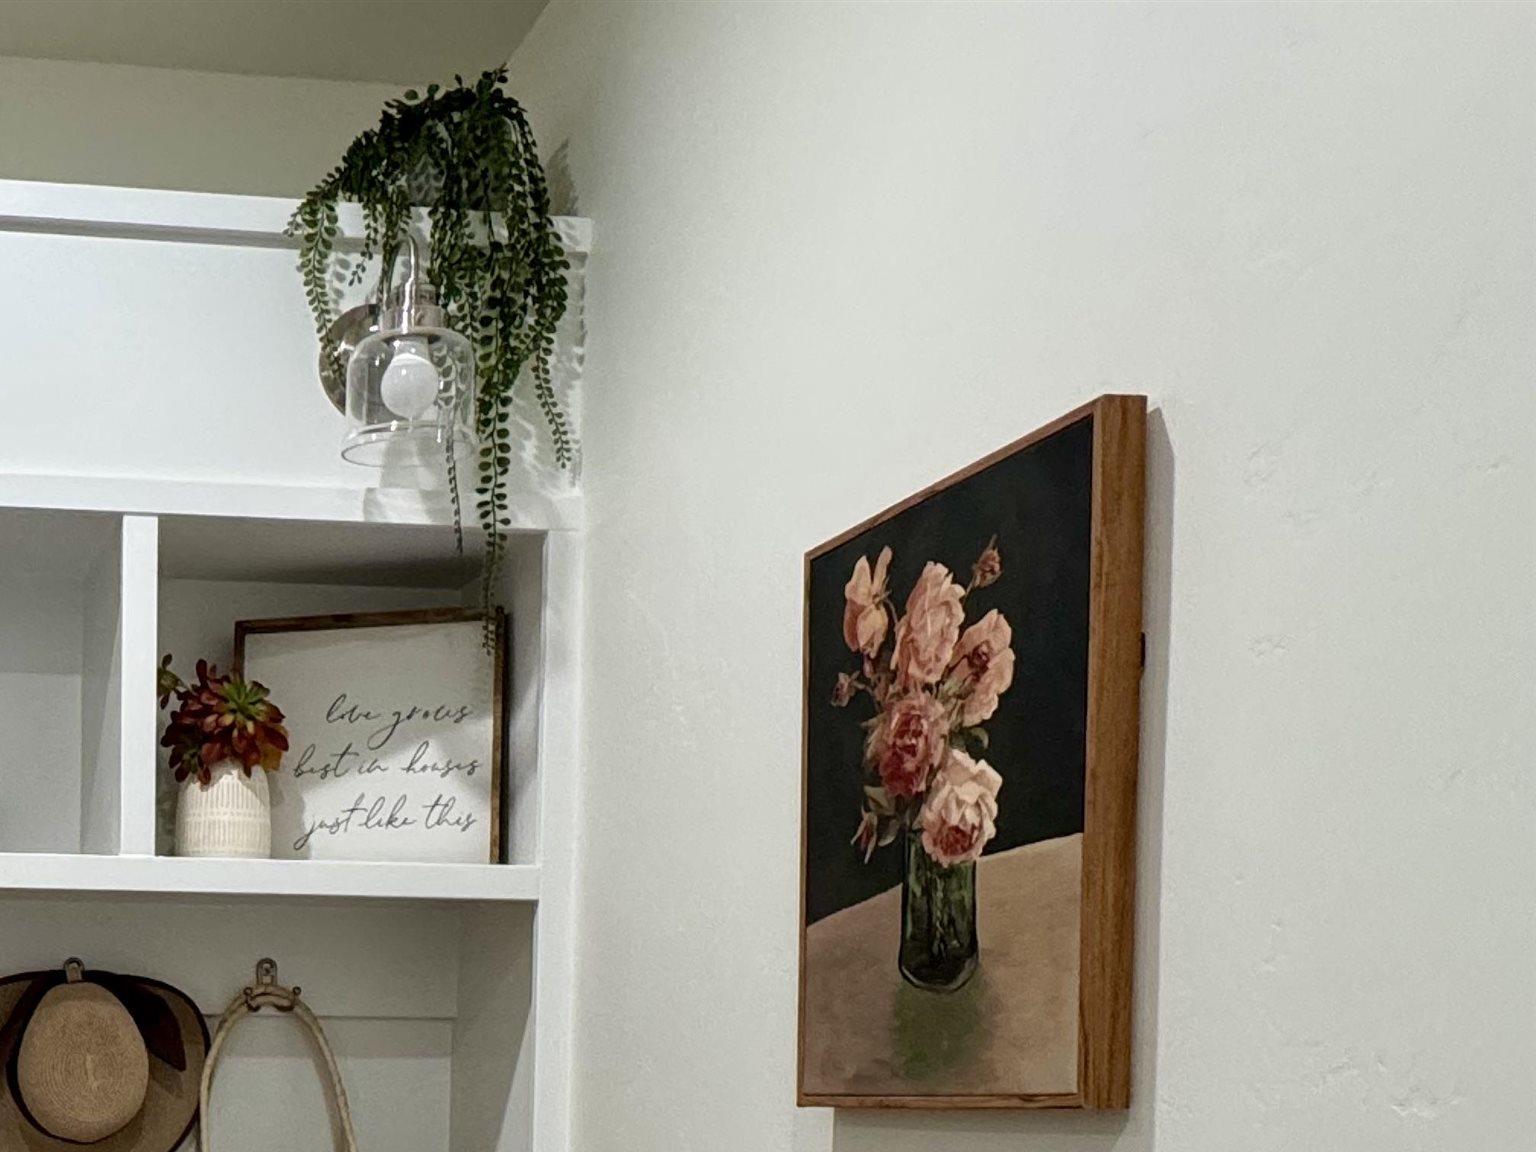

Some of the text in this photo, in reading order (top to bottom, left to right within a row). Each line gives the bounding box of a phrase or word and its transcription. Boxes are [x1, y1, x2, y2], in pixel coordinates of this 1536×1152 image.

[326, 693, 473, 751] love grows
[293, 740, 481, 780] best in houses
[293, 792, 477, 850] just like this
